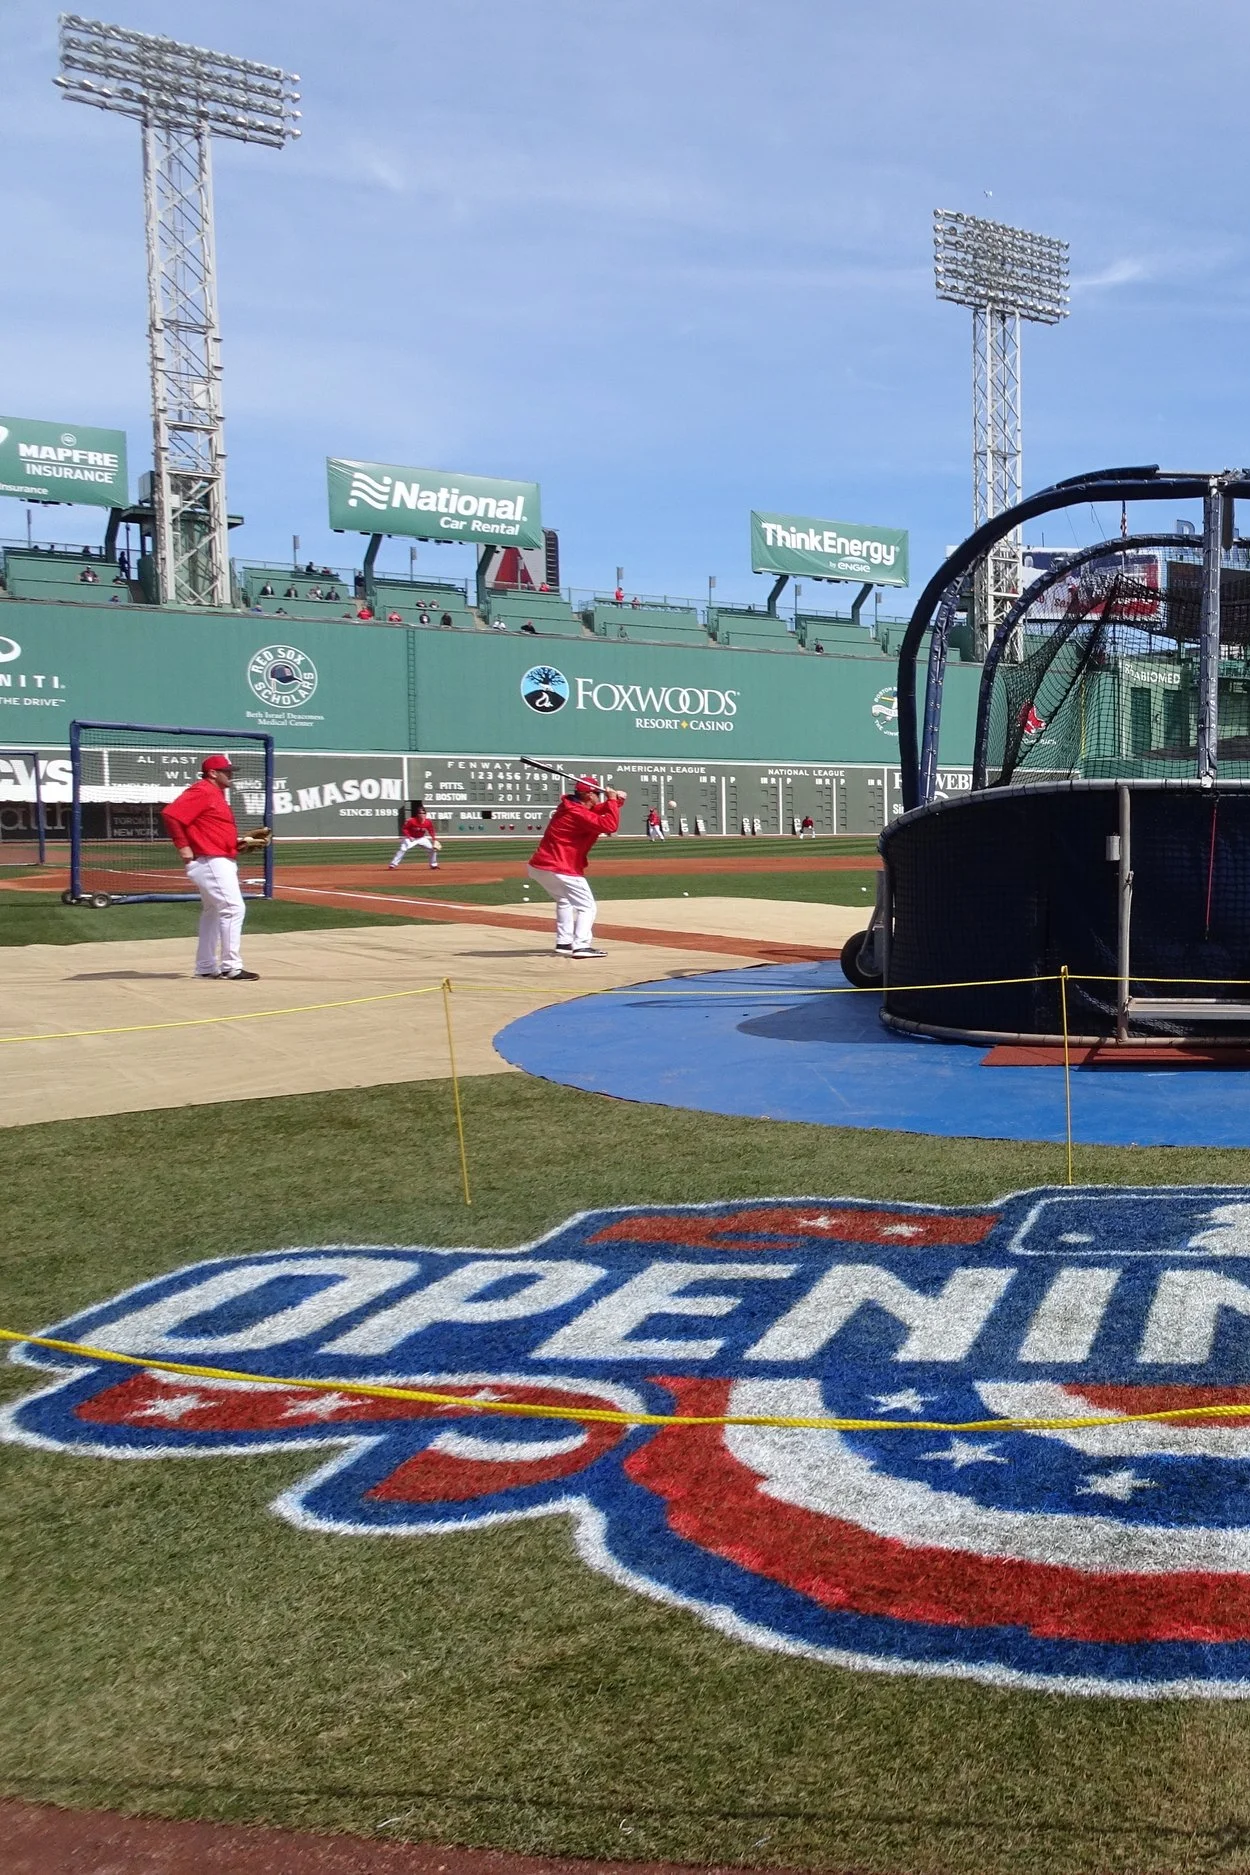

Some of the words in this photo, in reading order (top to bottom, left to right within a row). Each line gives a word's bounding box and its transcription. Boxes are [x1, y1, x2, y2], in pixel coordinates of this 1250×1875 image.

[18, 443, 119, 468] MAPFRE
[25, 463, 117, 484] INSURANCE
[391, 480, 526, 522] National
[439, 517, 467, 531] Car
[471, 520, 520, 536] Rental
[761, 521, 897, 566] ThinkEnergy
[250, 650, 274, 674] RED
[277, 647, 306, 666] SOX
[1133, 670, 1181, 685] ABIOMED
[254, 672, 315, 705] SCHOLARS
[575, 677, 737, 716] FOXWOODS
[636, 718, 681, 730] RESORT
[690, 720, 734, 732] CASINO
[137, 755, 155, 764] AL
[161, 756, 198, 765] EAST
[447, 761, 512, 771] FENWAY
[165, 771, 179, 779] W
[183, 771, 191, 779] L
[424, 771, 432, 779] P
[617, 765, 666, 774] AMERICAN
[670, 766, 706, 774] LEAGUE
[768, 768, 809, 776] NATIONAL
[813, 769, 845, 777] LEAGUE
[436, 793, 468, 801] BOSTON
[339, 808, 373, 817] SINCE
[374, 808, 399, 817] 1898
[438, 812, 453, 820] BAT
[460, 812, 482, 820] BALL
[491, 812, 521, 820] STRIKE
[524, 812, 543, 820] OUT
